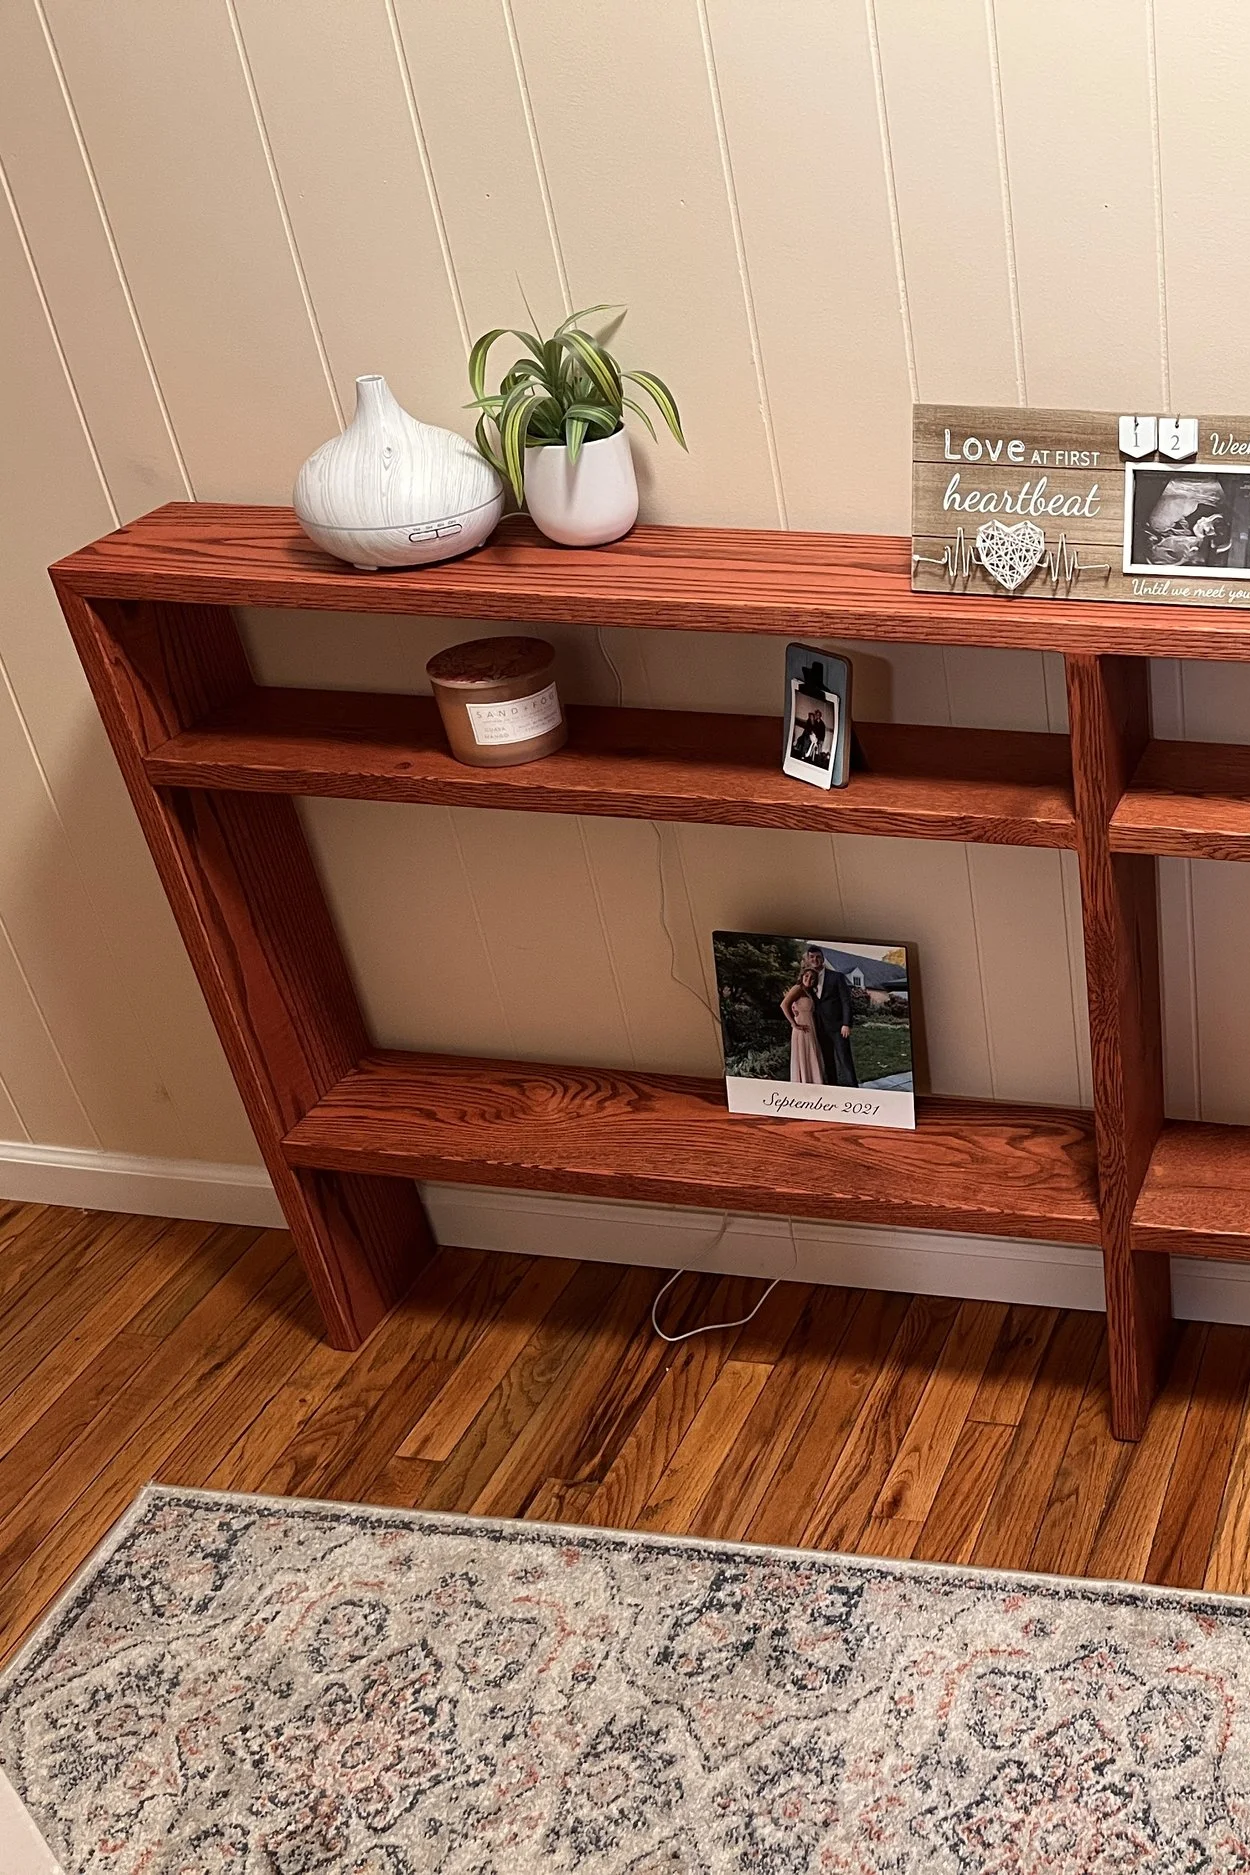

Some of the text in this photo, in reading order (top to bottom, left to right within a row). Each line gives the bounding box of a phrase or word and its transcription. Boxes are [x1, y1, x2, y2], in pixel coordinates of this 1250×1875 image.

[944, 428, 1101, 467] Love AT FIRST
[1132, 432, 1141, 448] 1
[1170, 434, 1181, 451] 2
[943, 472, 1101, 518] heartbeat
[1131, 578, 1171, 597] Until
[1171, 587, 1191, 597] we
[1193, 587, 1226, 599] meet
[476, 707, 519, 719] SAND
[532, 691, 555, 708] FOG
[762, 1091, 880, 1116] September 2021
